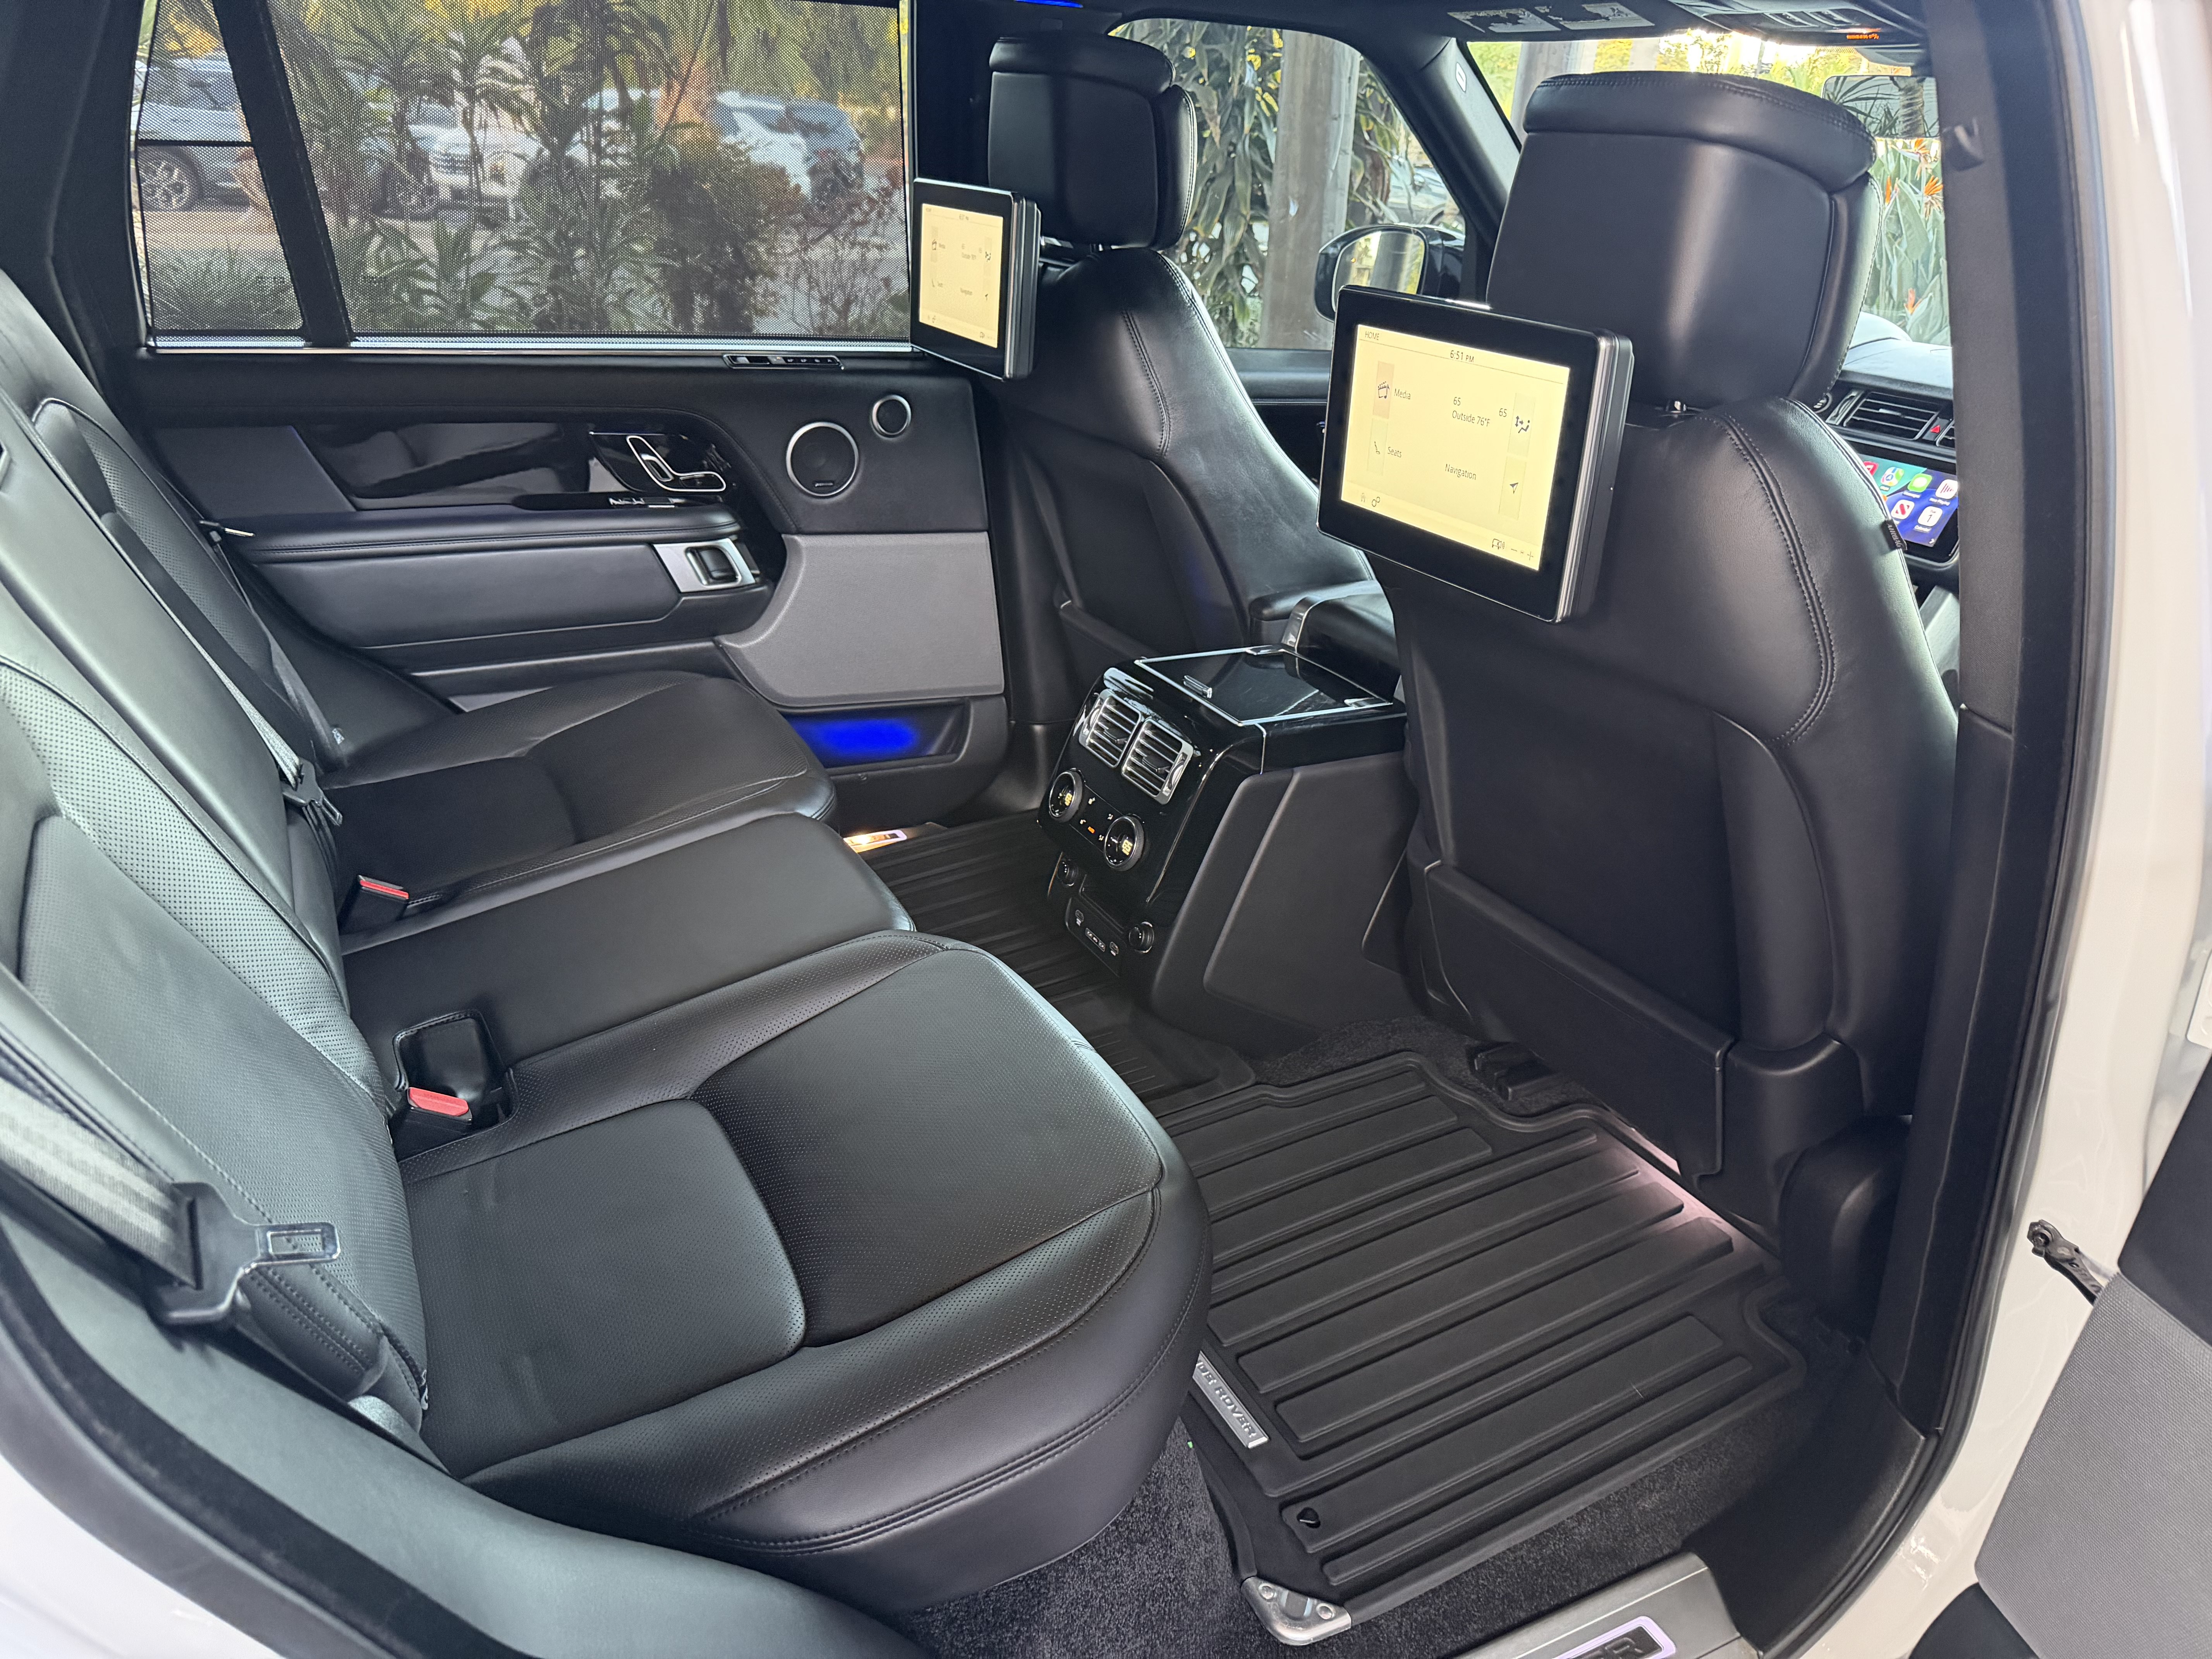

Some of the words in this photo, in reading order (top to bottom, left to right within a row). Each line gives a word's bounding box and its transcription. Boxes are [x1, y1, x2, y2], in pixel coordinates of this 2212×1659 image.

[1365, 331, 1379, 341] HOME
[1450, 350, 1463, 360] 6:51
[1394, 388, 1411, 400] Media
[1453, 397, 1461, 406] 65
[1452, 410, 1475, 423] Outside
[1499, 408, 1507, 417] 65
[1388, 447, 1402, 458] Seats
[1445, 464, 1477, 480] Navigation
[1886, 523, 1904, 548] AIRBAG
[1214, 1386, 1257, 1438] ROVER
